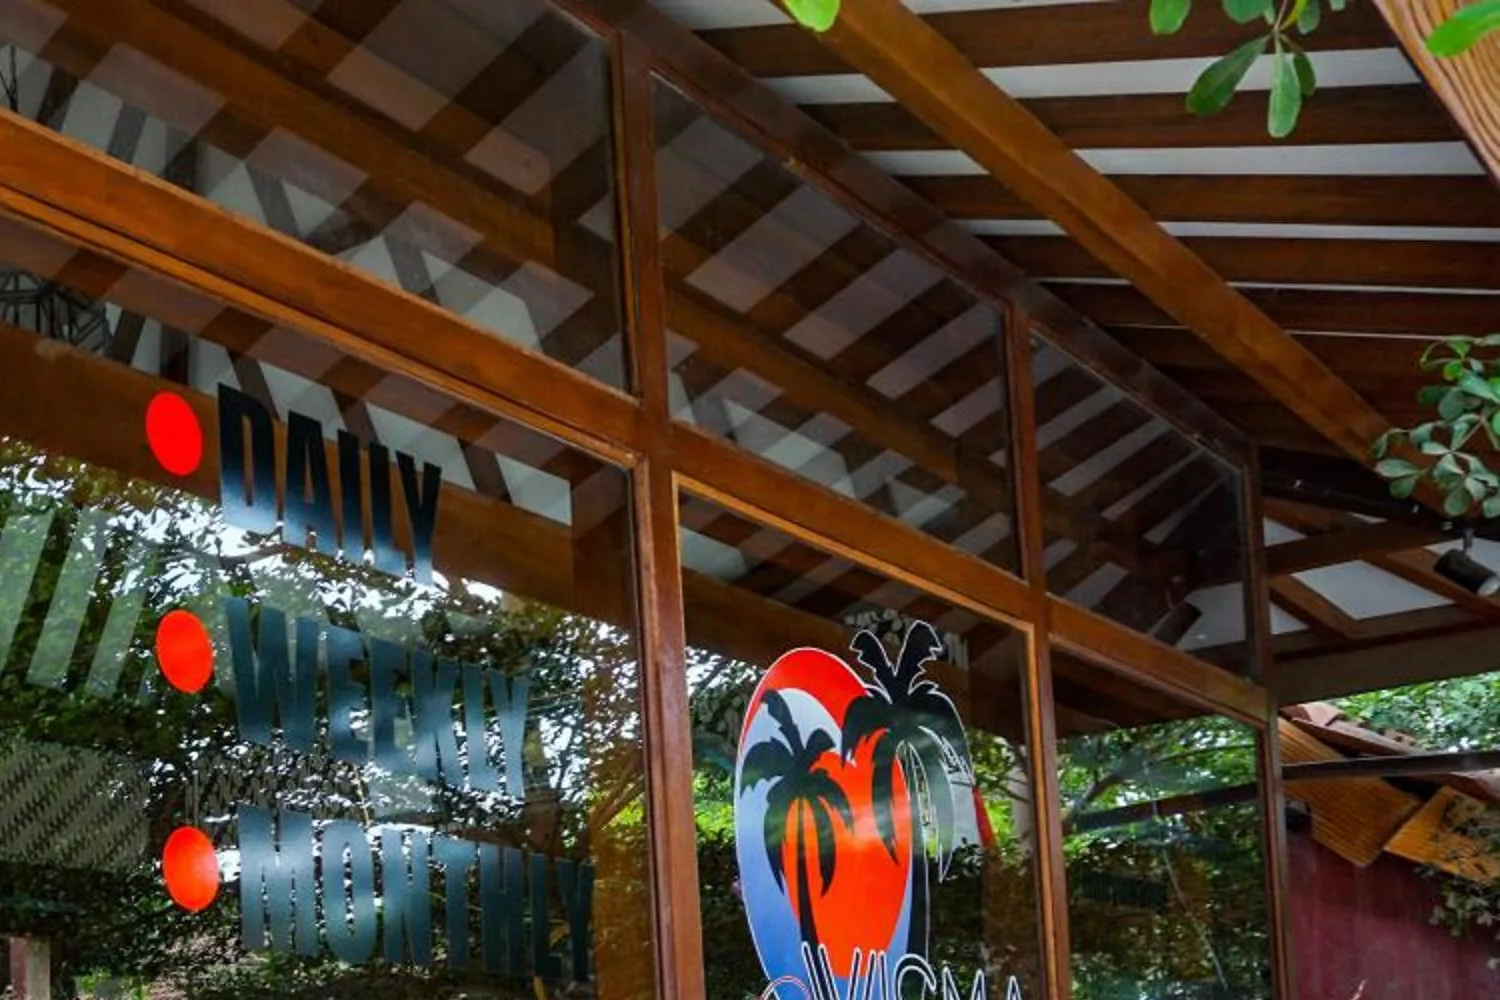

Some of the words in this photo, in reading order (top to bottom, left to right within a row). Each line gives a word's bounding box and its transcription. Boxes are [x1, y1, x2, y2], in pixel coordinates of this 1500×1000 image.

[217, 382, 442, 587] DAILY
[224, 594, 531, 798] WEEKLY
[237, 801, 599, 982] MONTHLY
